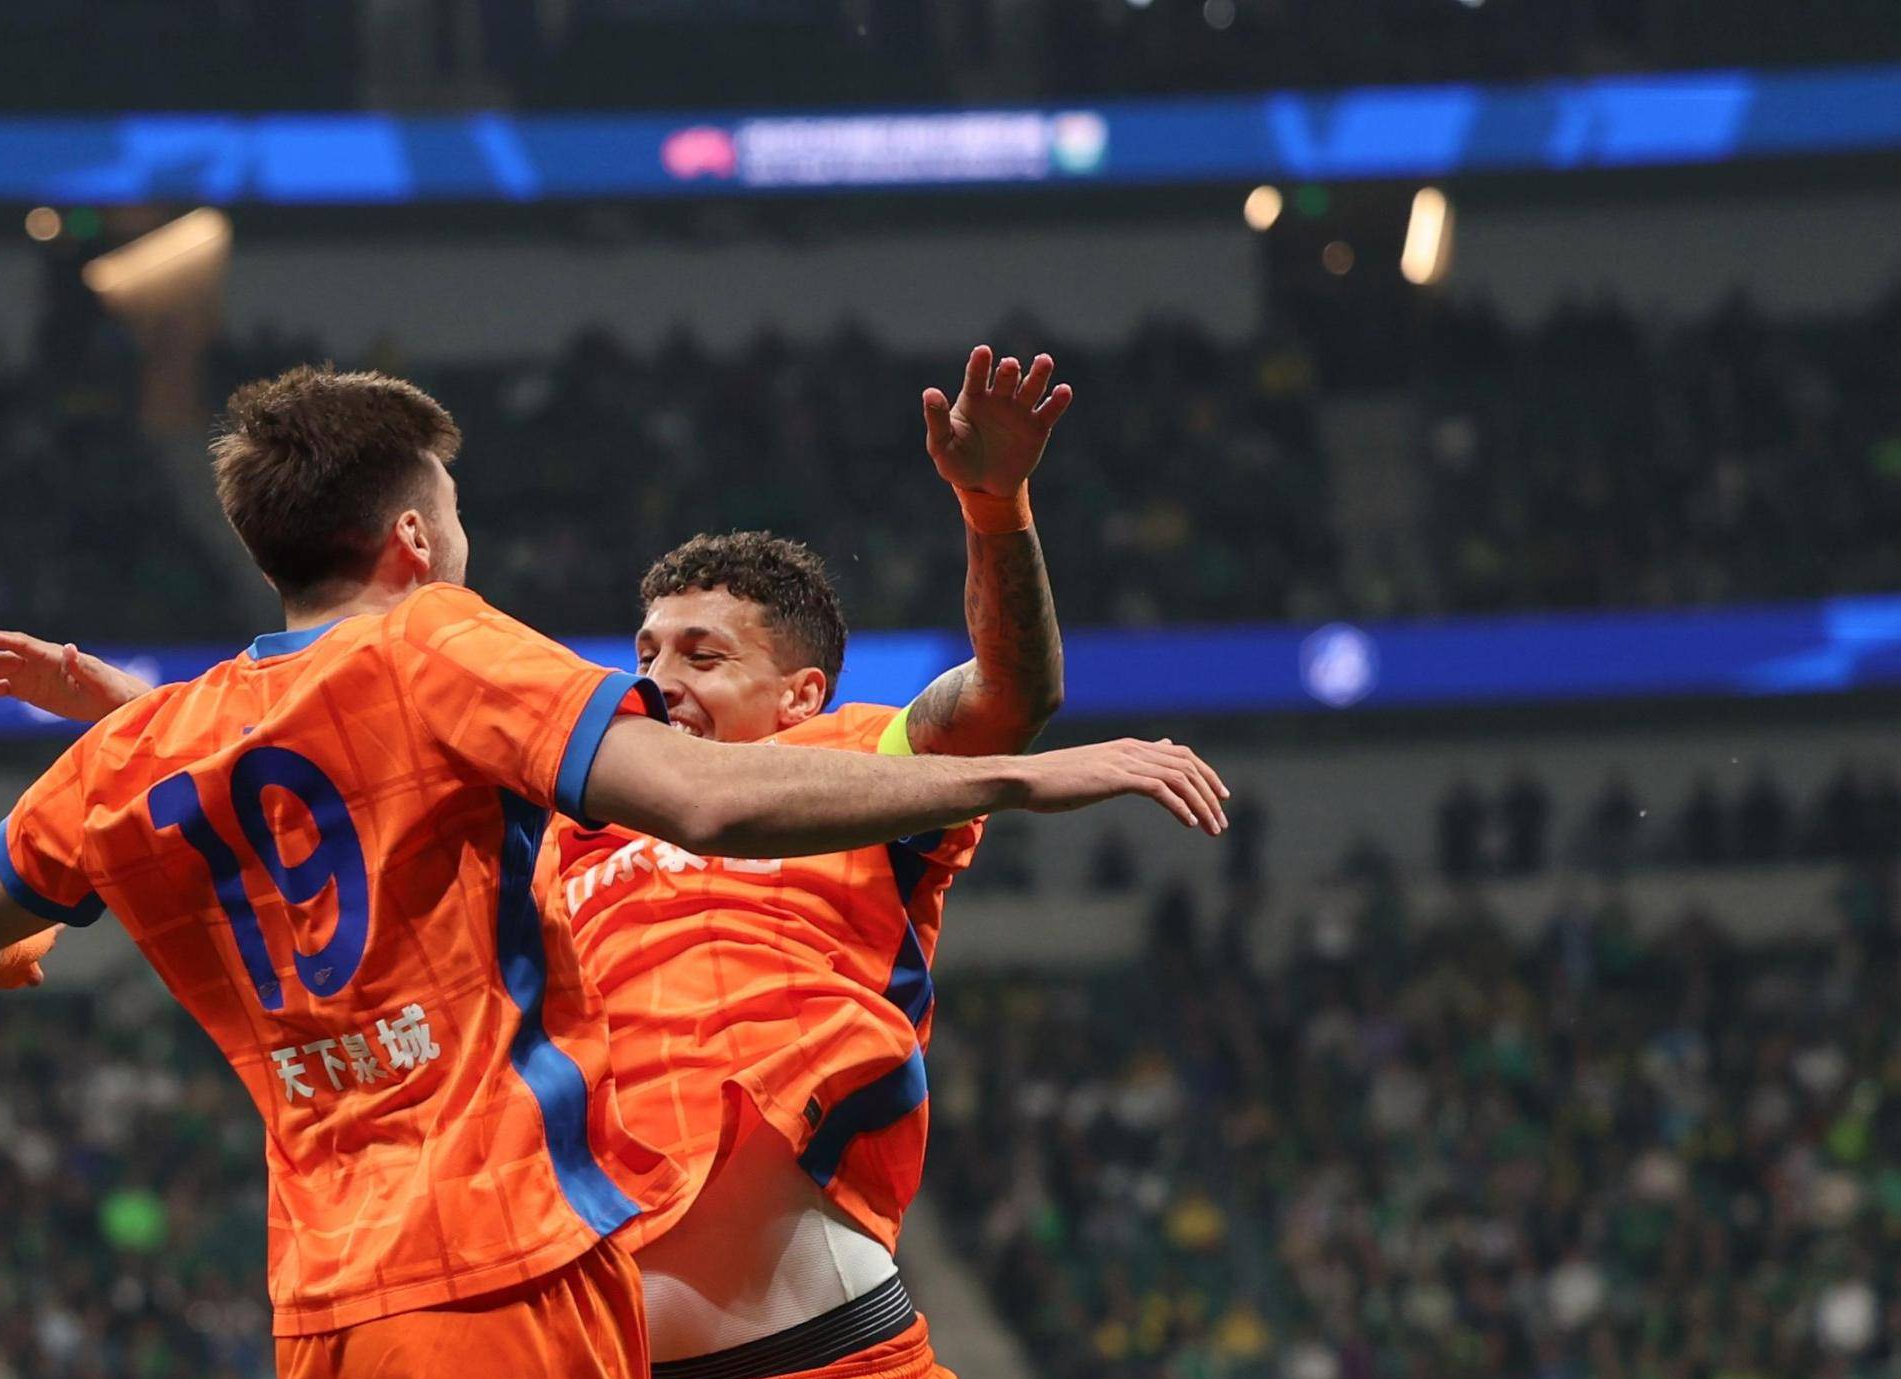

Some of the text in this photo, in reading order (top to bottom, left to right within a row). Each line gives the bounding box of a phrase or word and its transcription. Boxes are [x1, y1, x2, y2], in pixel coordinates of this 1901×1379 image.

[147, 746, 370, 1011] 19
[270, 1003, 441, 1103] 天下泉城
